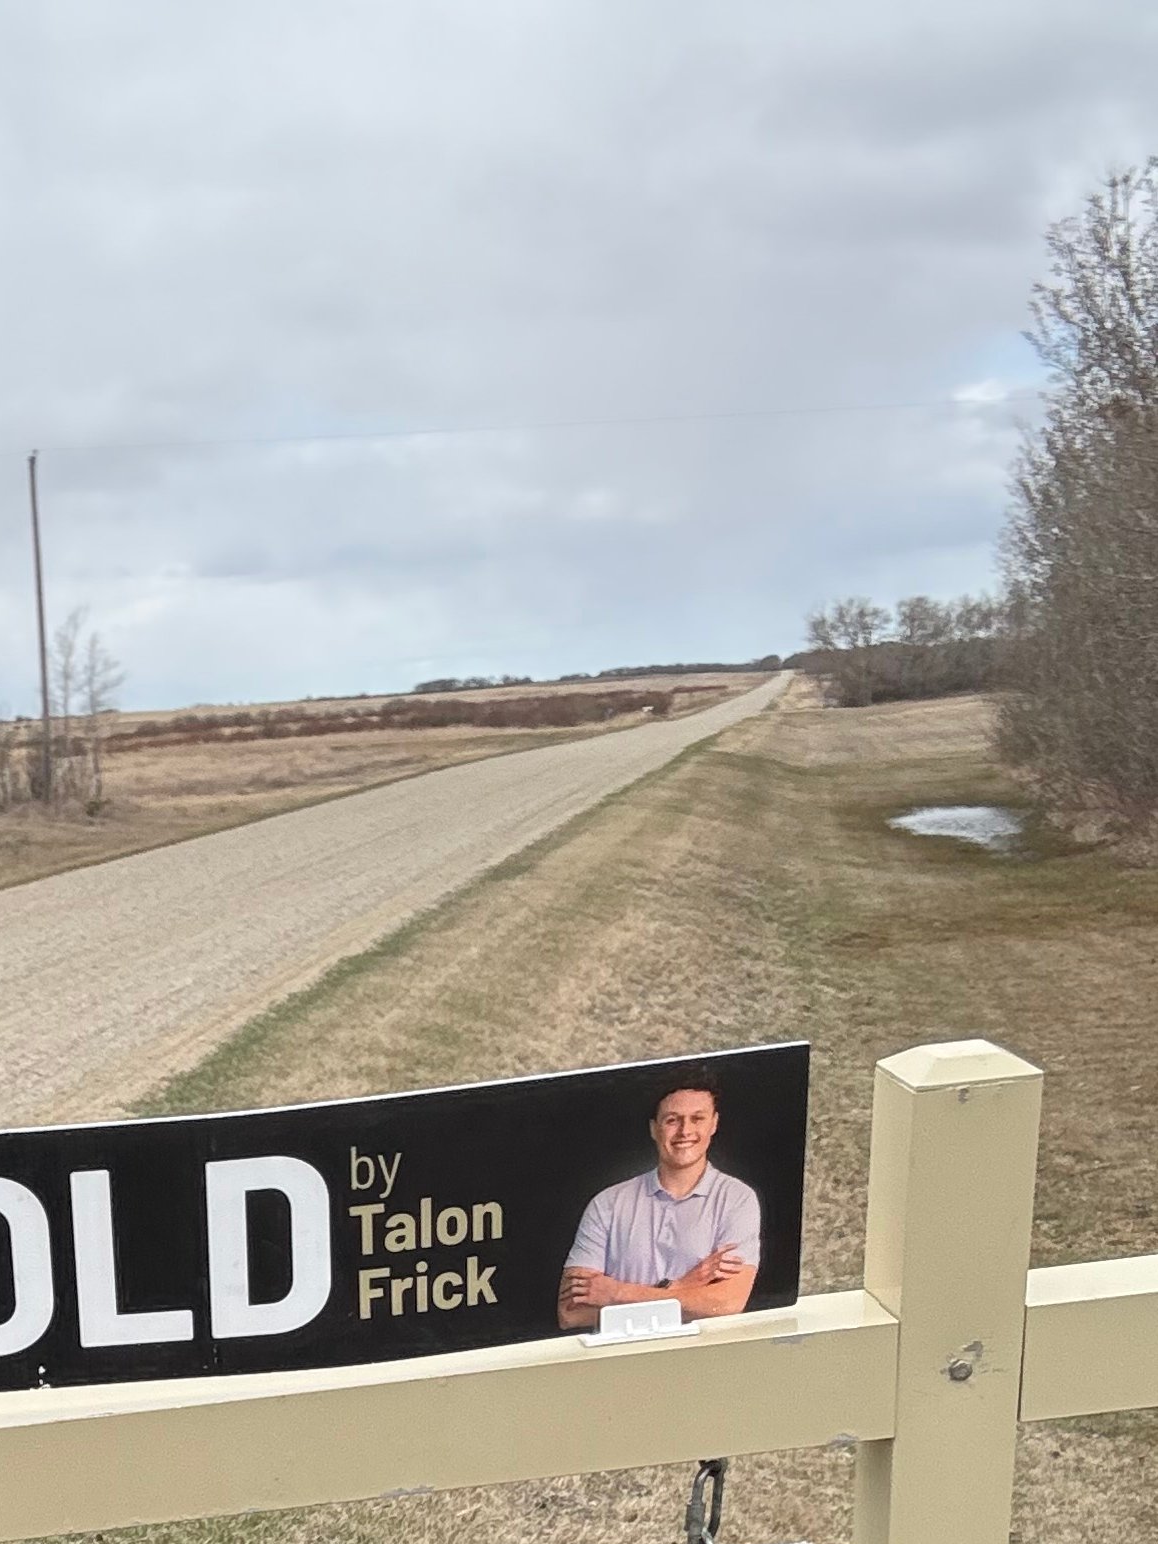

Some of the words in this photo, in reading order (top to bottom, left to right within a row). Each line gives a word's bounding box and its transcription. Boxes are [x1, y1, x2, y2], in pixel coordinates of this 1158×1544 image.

[350, 1146, 402, 1198] by
[349, 1197, 503, 1255] Talon
[358, 1256, 498, 1319] Frick
